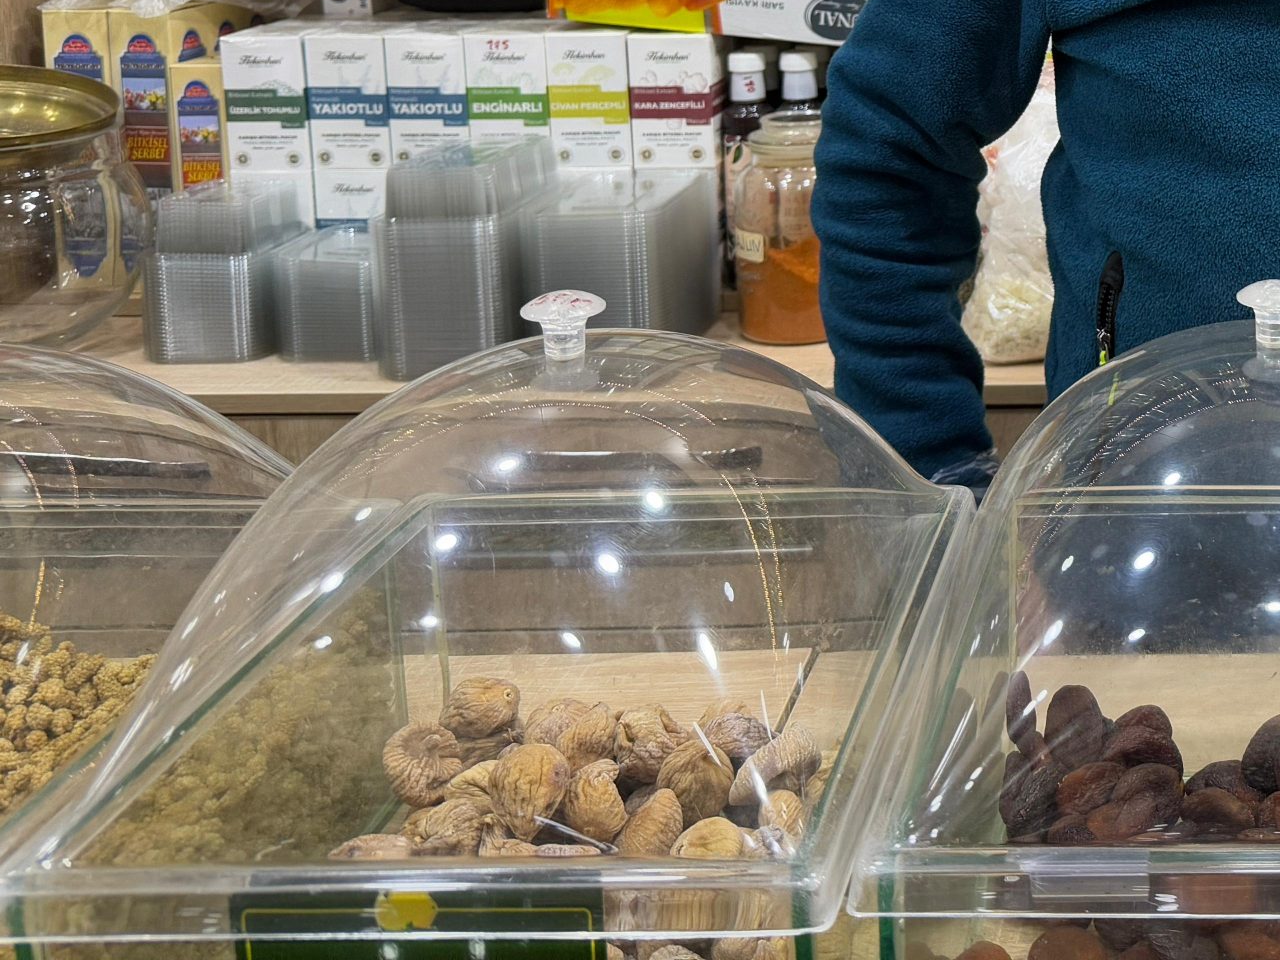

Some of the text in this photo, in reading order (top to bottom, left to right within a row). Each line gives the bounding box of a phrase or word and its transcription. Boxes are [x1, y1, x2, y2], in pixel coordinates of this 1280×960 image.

[312, 102, 384, 116] YAKIOTLU
[391, 102, 464, 116] YAKIOTLU
[472, 98, 544, 114] ENGİNARLI
[634, 100, 659, 111] KARA
